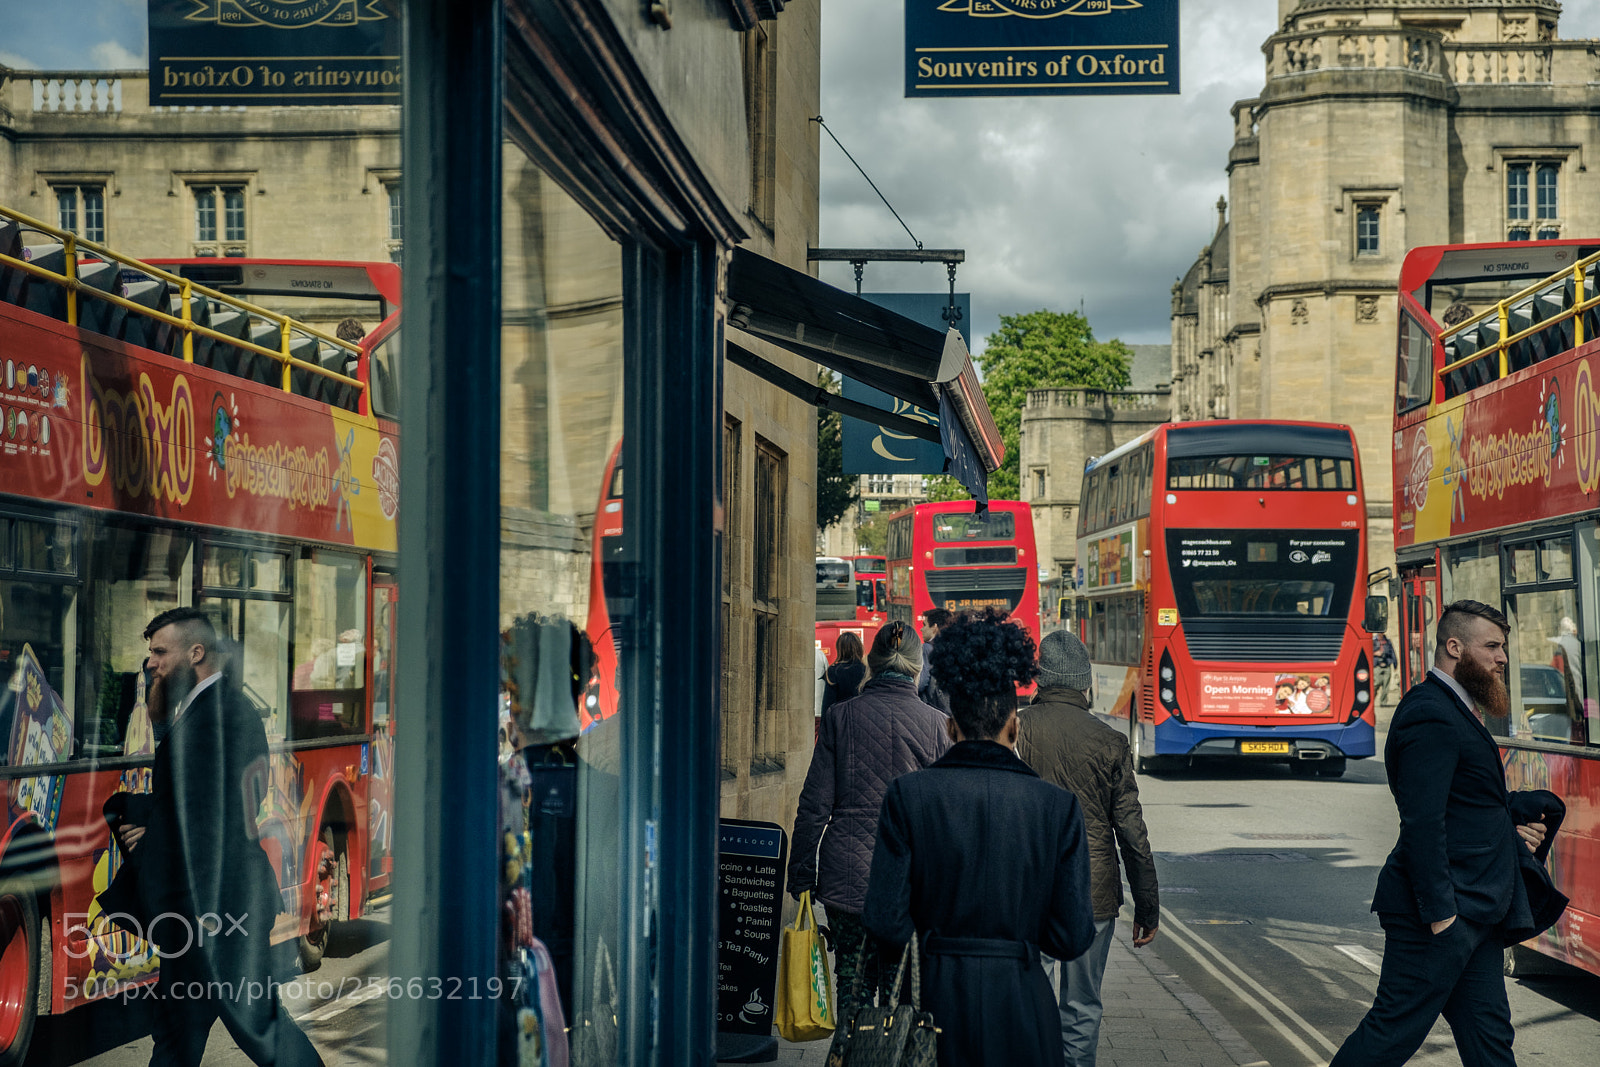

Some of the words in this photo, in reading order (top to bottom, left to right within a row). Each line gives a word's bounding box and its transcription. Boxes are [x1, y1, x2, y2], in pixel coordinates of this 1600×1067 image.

[975, 2, 994, 11] Est.
[1087, 1, 1106, 10] 1991
[917, 56, 1038, 78] Souvenirs
[1045, 55, 1071, 76] of
[1076, 54, 1165, 76] Oxford
[1483, 264, 1494, 273] NO
[1496, 262, 1529, 272] STANDING
[945, 599, 956, 612] 13
[959, 599, 971, 607] JR
[972, 598, 1007, 607] Hospital
[1204, 685, 1230, 696] Open
[1232, 685, 1273, 696] Morning
[1248, 743, 1267, 751] SK15
[721, 836, 774, 846] AFELOCO
[719, 862, 743, 872] ccino
[754, 864, 776, 875] Latte
[724, 875, 776, 888] Sandwiches
[731, 888, 774, 900] Baguettes
[738, 902, 773, 914] Toasties
[745, 916, 772, 927] Panini
[743, 929, 771, 940] Soups
[725, 940, 741, 954] Tea
[743, 945, 770, 965] Party!
[719, 962, 732, 971] Tea
